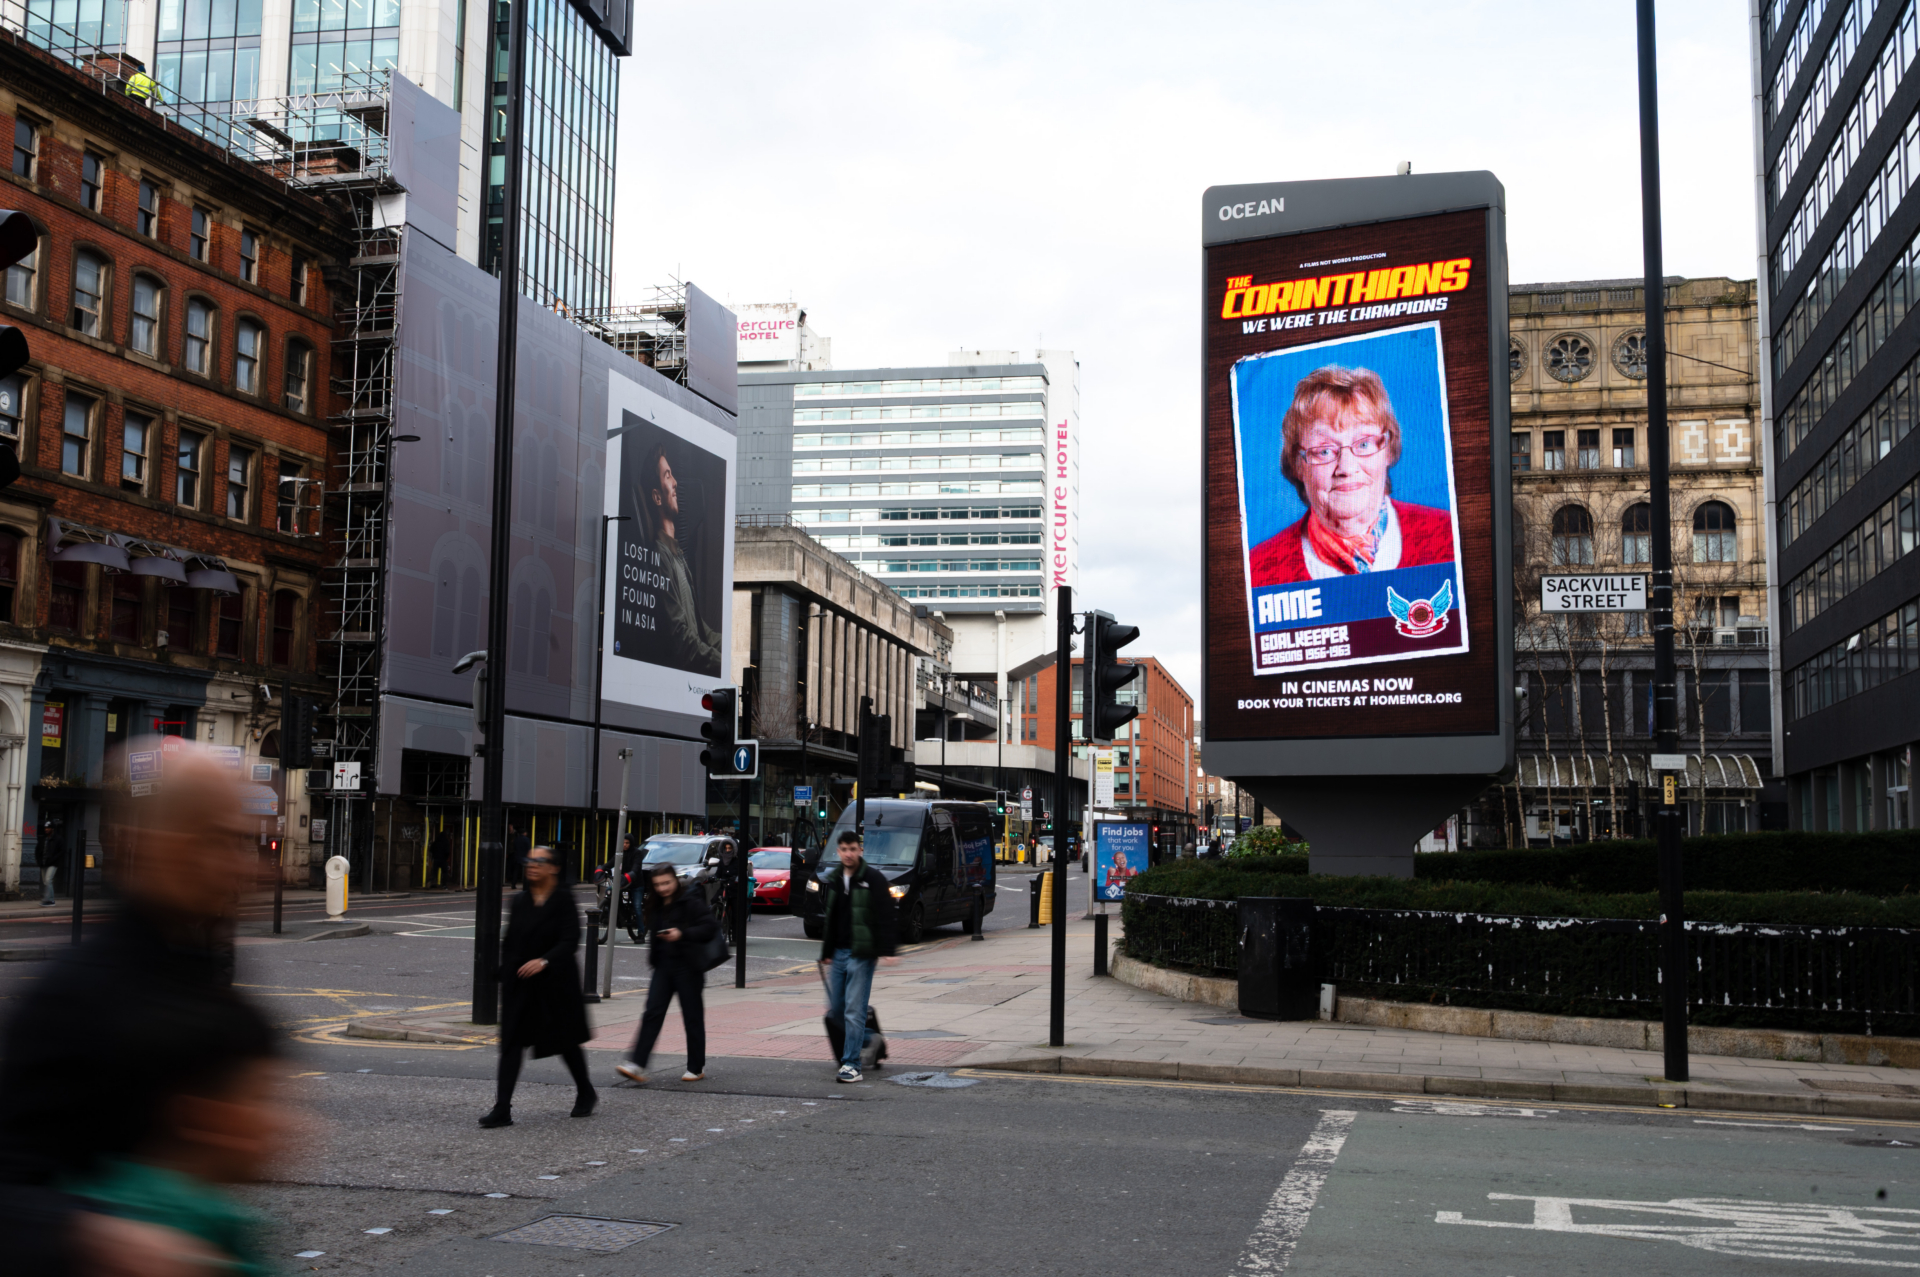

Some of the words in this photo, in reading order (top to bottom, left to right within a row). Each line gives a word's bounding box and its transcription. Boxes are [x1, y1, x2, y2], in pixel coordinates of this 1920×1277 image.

[1218, 197, 1284, 221] OCEAN
[1332, 257, 1351, 265] WORDS
[1352, 252, 1387, 262] PRODUCTION
[1221, 257, 1472, 320] CORINTHIANS
[1226, 274, 1253, 290] THE
[737, 320, 795, 332] ercure
[1242, 319, 1268, 335] WE
[1270, 313, 1316, 331] WERE
[1318, 309, 1349, 326] THE
[1350, 297, 1449, 322] CHAMPIONS
[739, 332, 779, 341] HOTEL
[1057, 419, 1068, 478] HOTEL
[624, 541, 648, 562] LOST
[651, 551, 660, 567] IN
[623, 564, 670, 592] COMFORT
[1546, 577, 1642, 593] SACKVILLE
[623, 586, 656, 609] FOUND
[1258, 587, 1322, 625] ANNE
[1561, 594, 1627, 609] STREET
[622, 608, 632, 625] IN
[635, 612, 656, 631] ASIA
[1260, 625, 1350, 652] GOALKEEPER
[1261, 649, 1303, 666] SEASONS
[1305, 644, 1351, 661] 1956-1963
[1282, 681, 1298, 695] IN
[1302, 679, 1370, 694] CINEMAS
[1373, 677, 1413, 691] NOW
[1237, 699, 1270, 709] BOOK
[1272, 698, 1303, 708] YOUR
[1306, 696, 1350, 707] TICKETS
[1353, 696, 1367, 706] AT
[1370, 693, 1462, 706] HOMEMCR.ORG
[1666, 778, 1672, 787] 2
[1666, 790, 1673, 798] 3
[1102, 827, 1122, 836] Find
[1123, 827, 1144, 837] jobs
